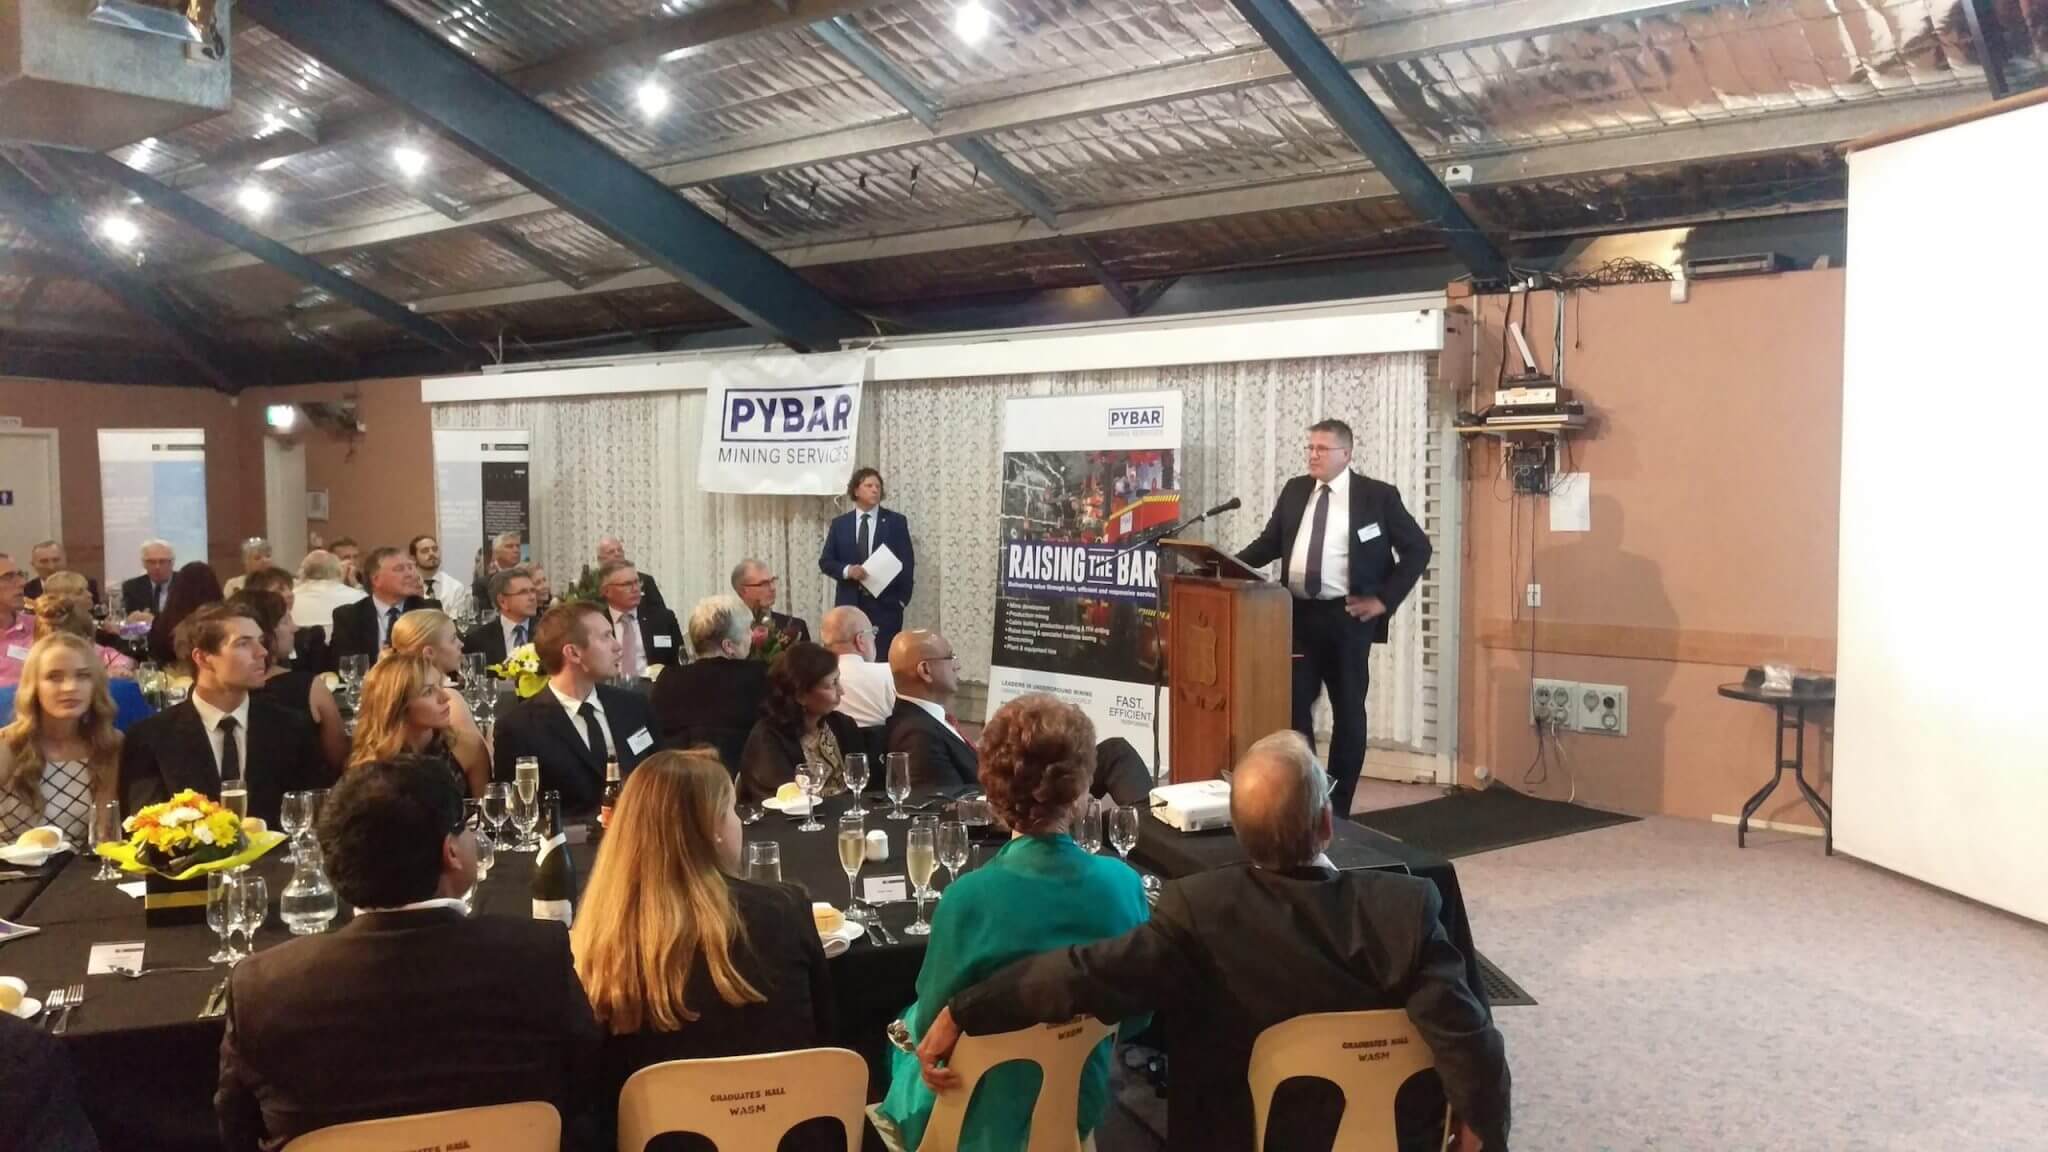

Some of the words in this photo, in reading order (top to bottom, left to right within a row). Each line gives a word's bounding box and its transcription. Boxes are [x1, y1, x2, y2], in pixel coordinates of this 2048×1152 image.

[730, 394, 852, 433] PYBAR
[1111, 410, 1161, 426] PYBAR
[718, 447, 781, 464] MINING
[787, 446, 849, 464] SERVICES
[1008, 544, 1086, 583] RAISING
[1088, 555, 1113, 578] THE
[1117, 550, 1158, 589] BAR
[1116, 695, 1144, 710] FAST.
[1358, 1051, 1390, 1061] WASM
[710, 1090, 761, 1102] GRADUATES
[764, 1087, 786, 1097] HALL
[729, 1104, 766, 1116] WASM
